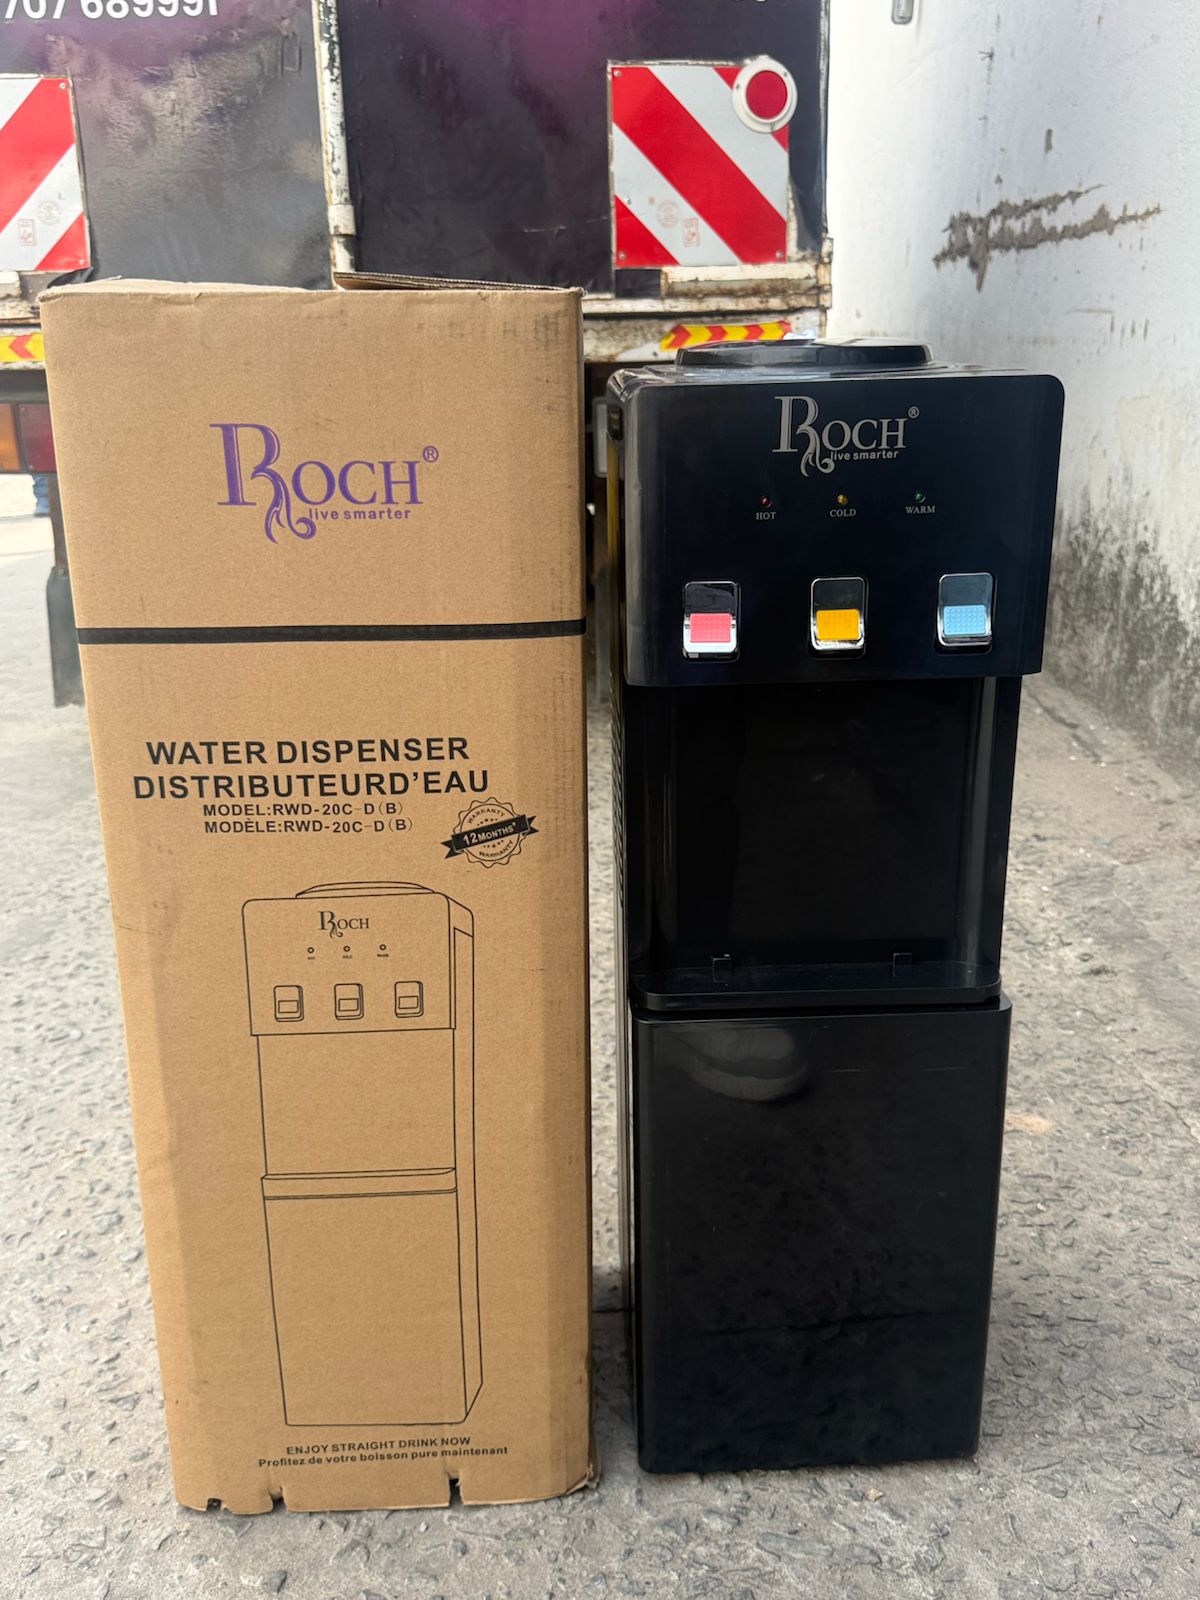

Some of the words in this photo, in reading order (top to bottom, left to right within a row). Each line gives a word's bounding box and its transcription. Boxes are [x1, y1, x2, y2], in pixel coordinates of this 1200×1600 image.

[831, 451, 851, 461] live
[852, 451, 899, 459] smarter
[308, 508, 339, 520] live
[343, 508, 411, 520] smarter
[755, 511, 777, 520] HOT
[829, 508, 857, 517] COLD
[905, 505, 936, 514] WARM
[146, 741, 266, 765] WATER
[276, 737, 470, 763] DISPENSER
[468, 808, 505, 824] WARRANTY
[478, 839, 514, 858] WARRANTY
[317, 910, 370, 938] ROCH
[286, 1444, 329, 1455] ENJOY
[331, 1440, 396, 1451] STRAIGHT
[398, 1438, 438, 1448] DRINK
[441, 1436, 472, 1446] NOW
[258, 1457, 306, 1467] Profitez
[308, 1456, 323, 1465] de
[326, 1454, 357, 1463] votre
[360, 1451, 409, 1462] boisson
[411, 1449, 438, 1460] pure
[441, 1446, 509, 1456] maintenant
